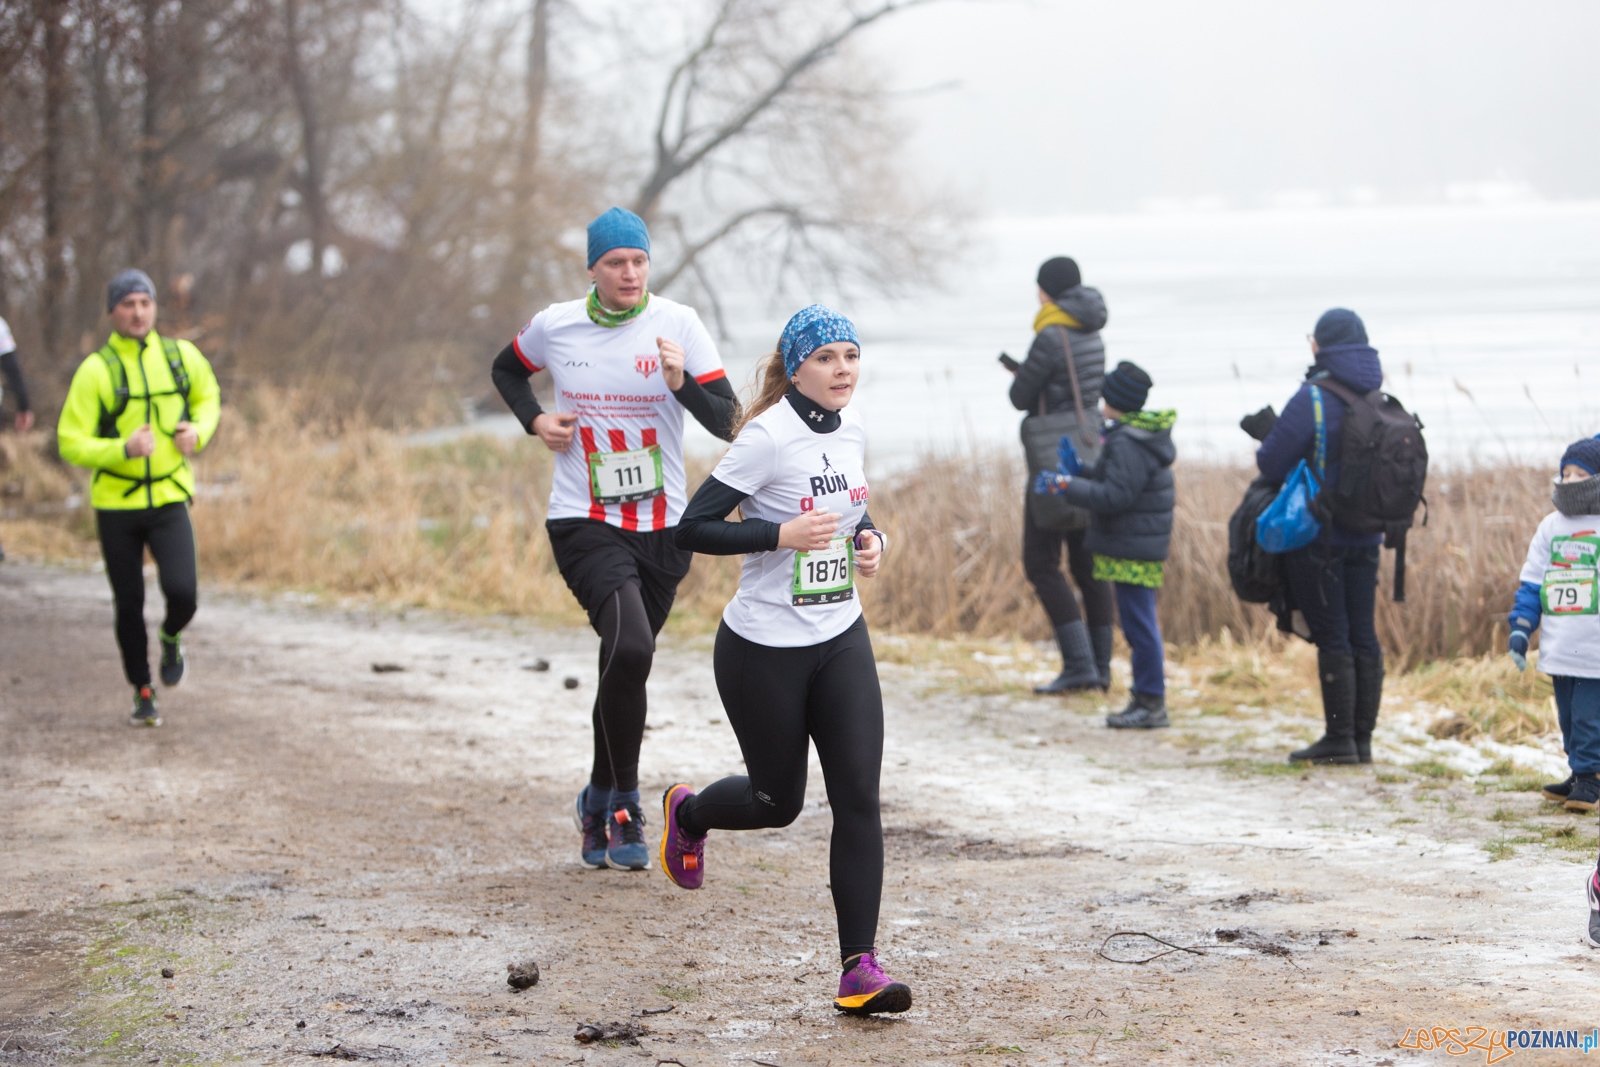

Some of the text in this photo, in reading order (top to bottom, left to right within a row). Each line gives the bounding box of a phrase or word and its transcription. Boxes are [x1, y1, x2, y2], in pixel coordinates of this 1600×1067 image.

[561, 389, 667, 403] POLONIA BYDGOSZCZ
[614, 465, 642, 487] 111
[809, 473, 849, 497] RUN
[806, 557, 847, 583] 1876
[1554, 587, 1578, 605] 79
